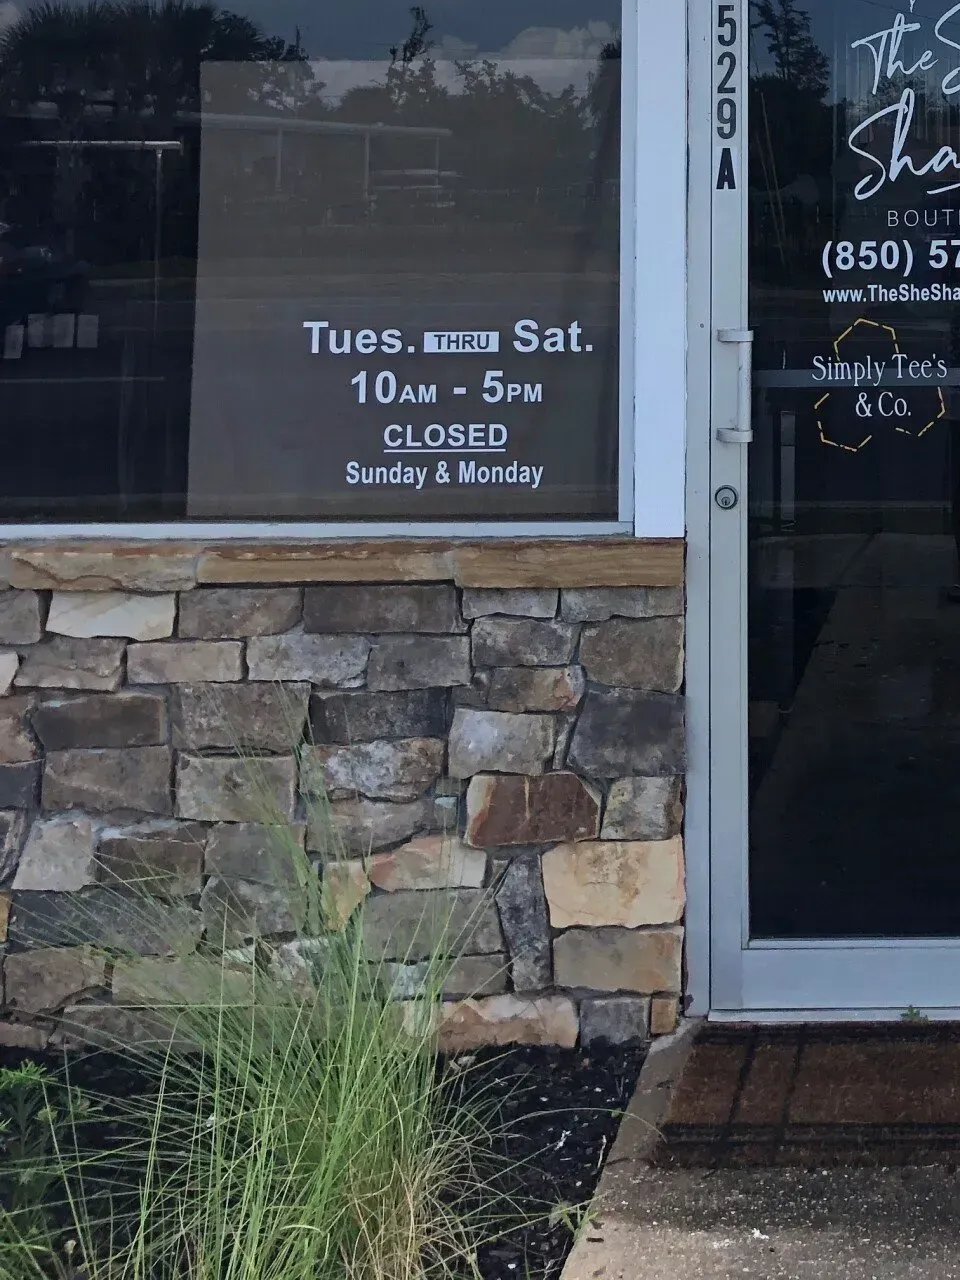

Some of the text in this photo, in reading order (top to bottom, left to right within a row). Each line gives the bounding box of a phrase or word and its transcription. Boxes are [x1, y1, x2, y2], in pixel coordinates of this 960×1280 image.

[851, 13, 939, 94] The
[822, 240, 913, 277] (850)
[303, 318, 593, 354] Tues. THRU Sat.
[811, 353, 947, 386] Simply Tee's
[453, 386, 467, 395] -
[855, 391, 912, 417] & Co.
[383, 423, 508, 448] CLOSED
[346, 460, 544, 489] Sunday & Monday
